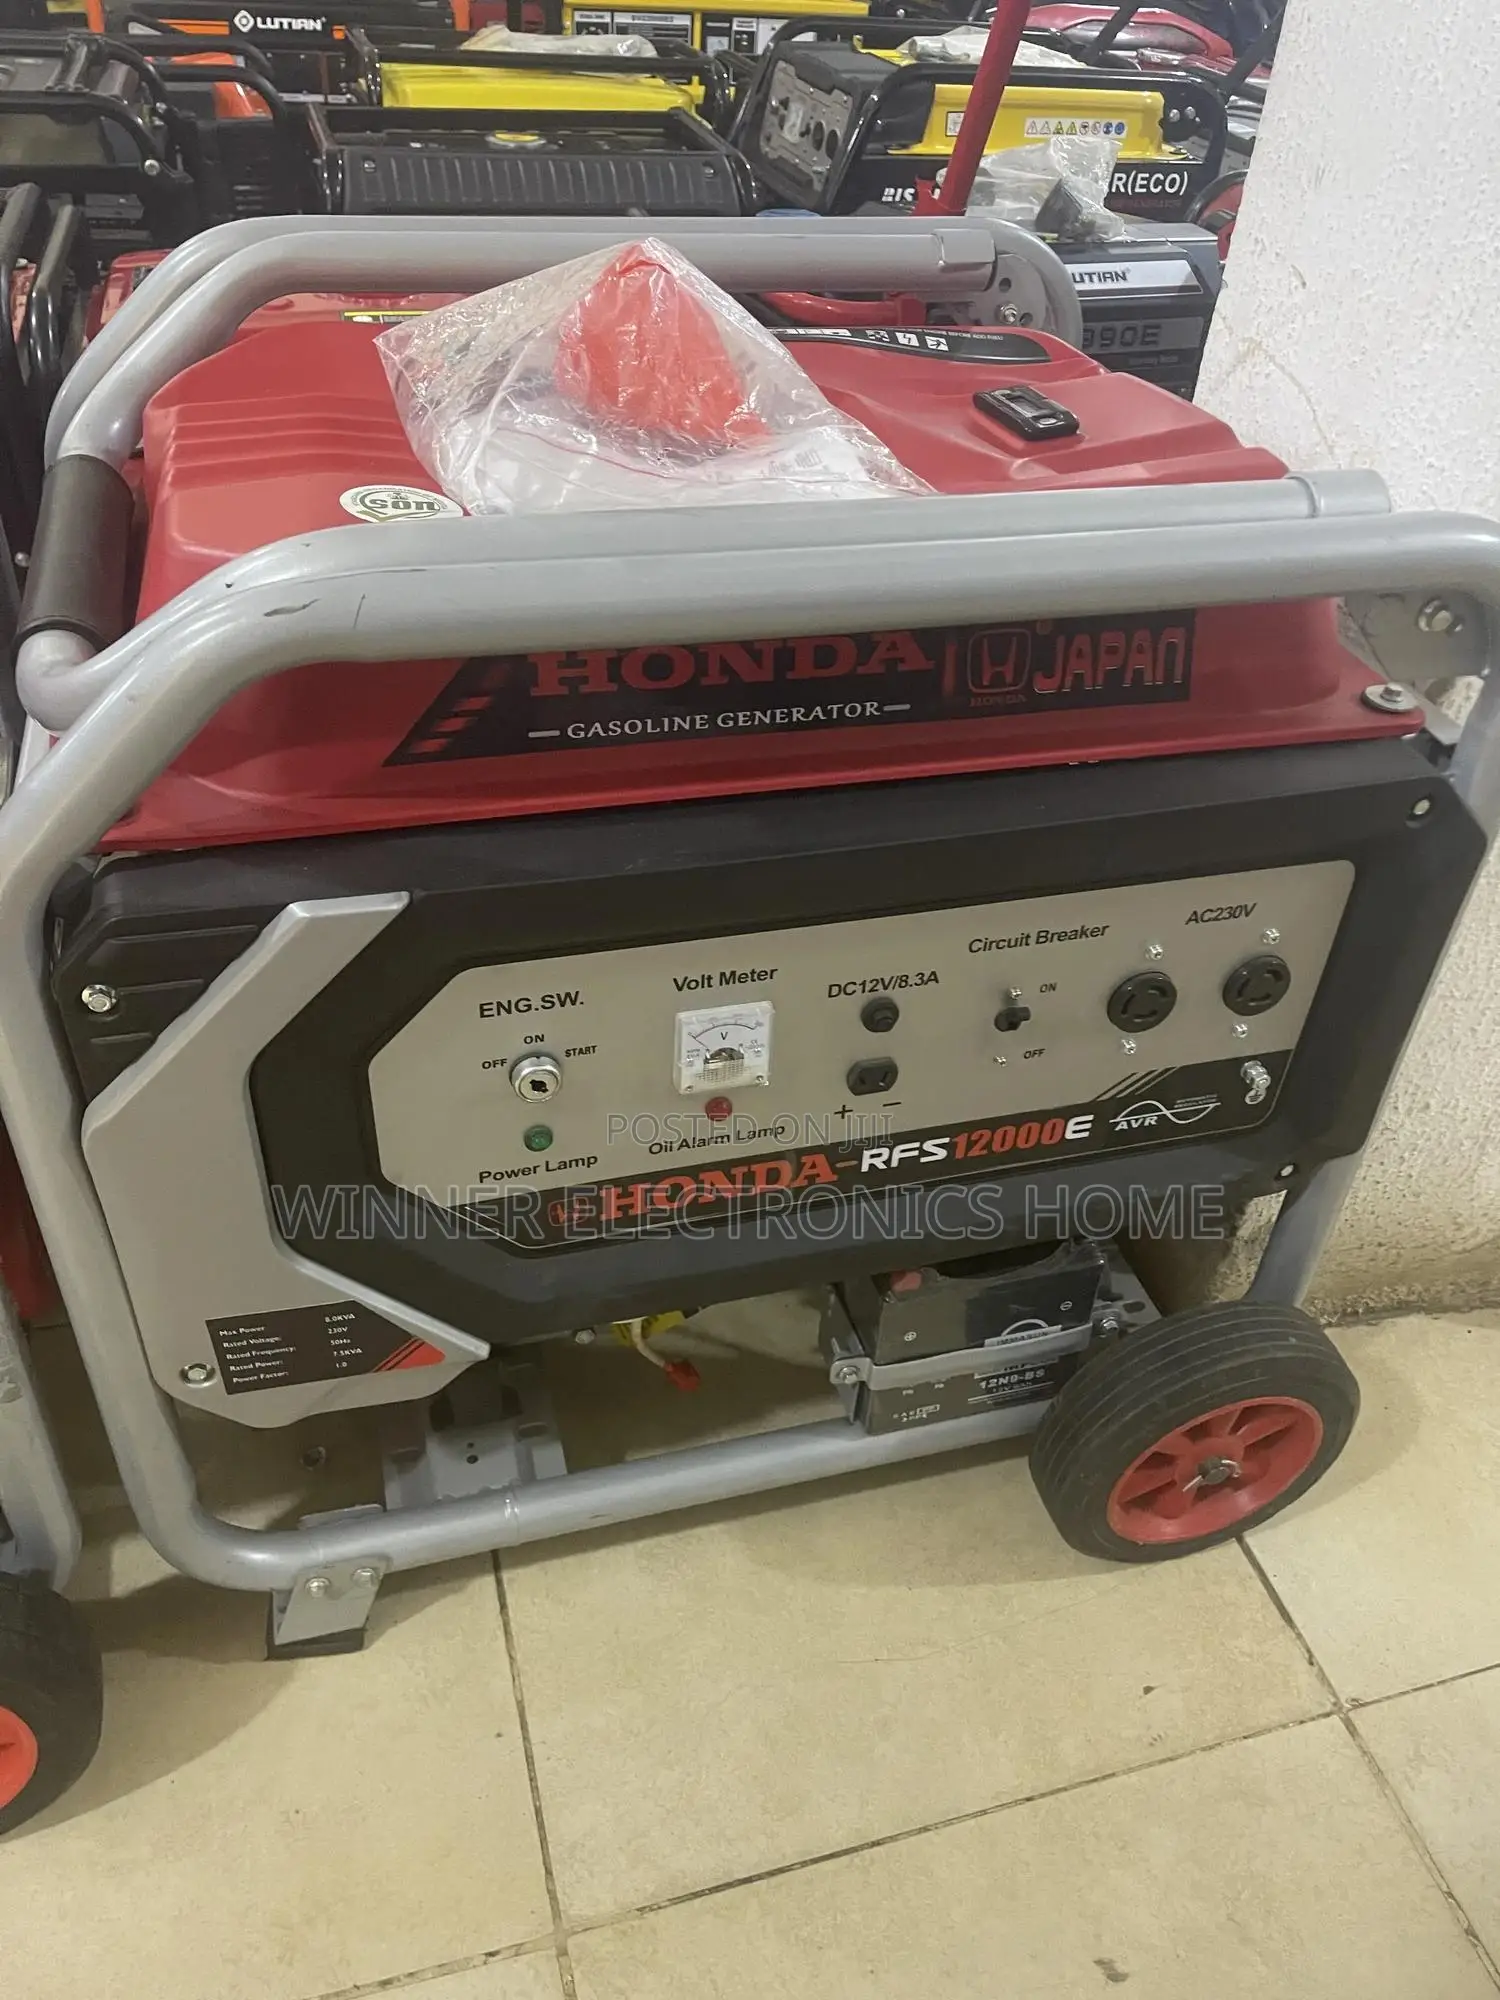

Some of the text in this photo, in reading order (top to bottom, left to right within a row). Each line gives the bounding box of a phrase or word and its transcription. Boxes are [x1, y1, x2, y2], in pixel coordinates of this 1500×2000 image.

[1111, 170, 1189, 196] R(ECO)
[1072, 271, 1128, 284] UTIAN
[526, 629, 936, 697] HONDA
[1032, 627, 1187, 694] JAPAN
[566, 701, 882, 740] GASOLINE GENERATOR
[1185, 902, 1258, 926] AC230V
[967, 921, 1110, 954] Circuit Breaker
[672, 966, 779, 993] Volt Meter
[826, 969, 940, 998] DC12V/8.3A
[1038, 982, 1058, 993] ON
[478, 990, 586, 1019] ENG.SW.
[523, 1033, 545, 1045] ON
[564, 1045, 598, 1058] START
[1022, 1048, 1046, 1060] OFF
[481, 1058, 509, 1071] OFF
[1114, 1116, 1159, 1131] AVR
[648, 1124, 786, 1155] Oil Alarm Lamp
[478, 1154, 599, 1184] Power Lamp
[239, 1326, 266, 1334] Power
[223, 1340, 248, 1348] Rated
[226, 1352, 251, 1360] Rated
[229, 1363, 254, 1371] Rated
